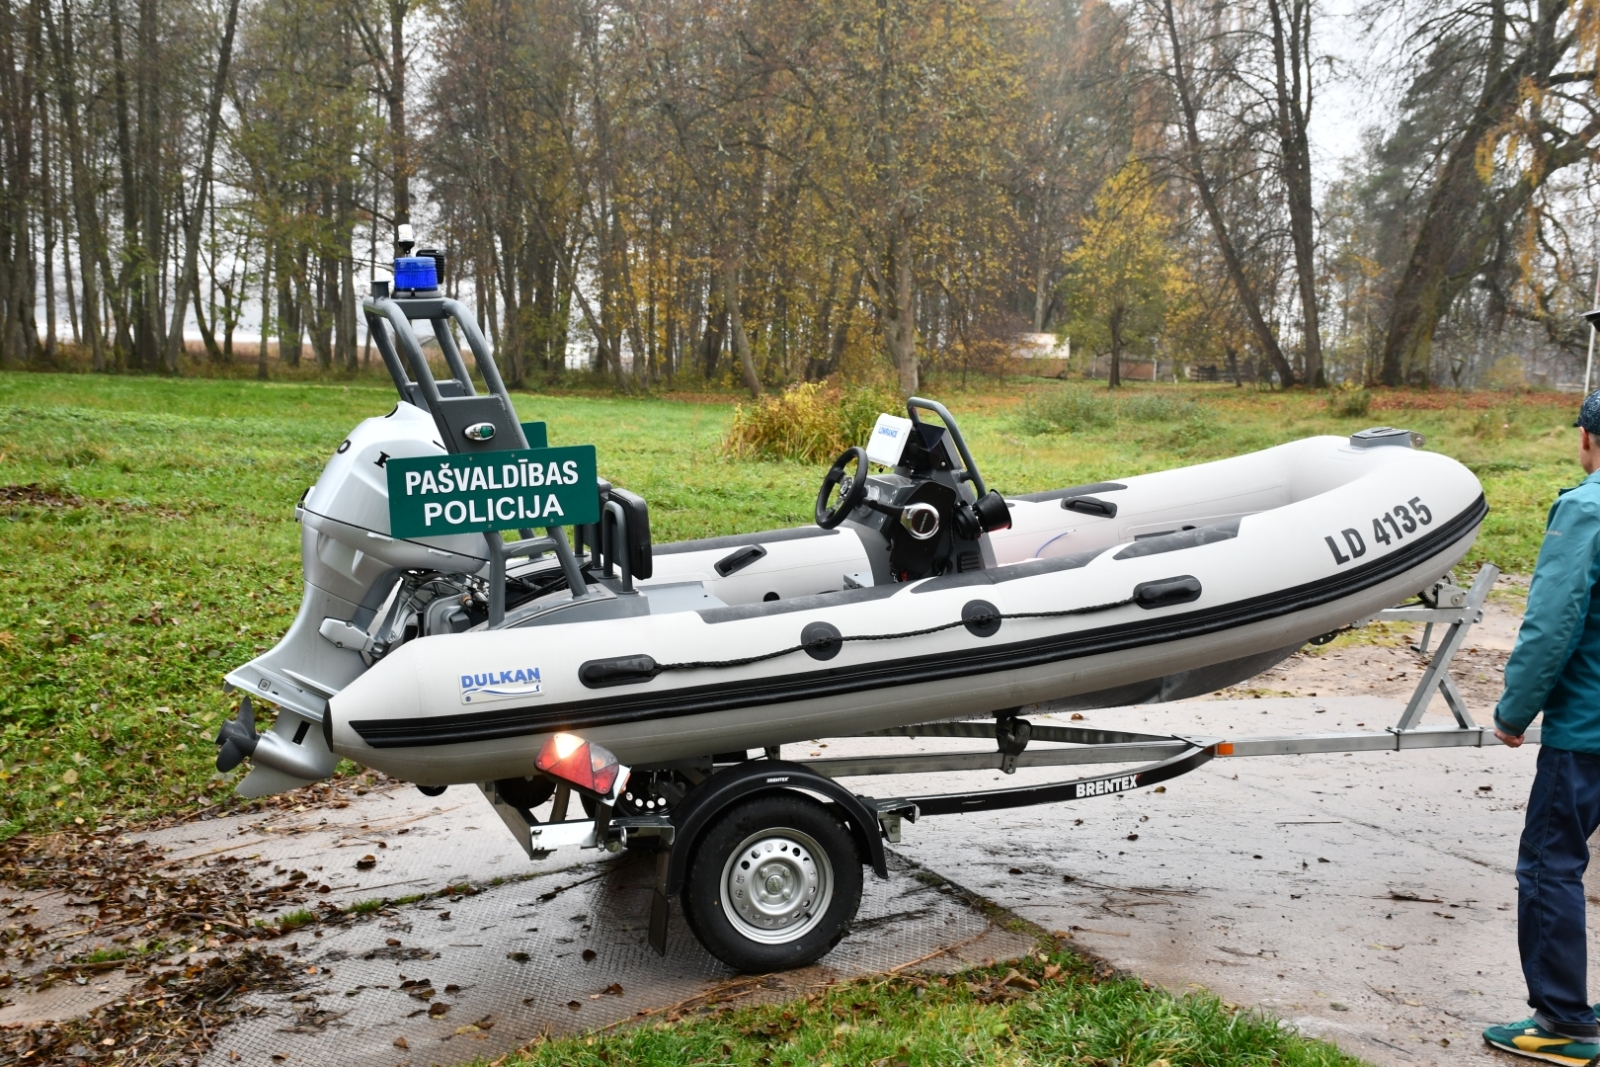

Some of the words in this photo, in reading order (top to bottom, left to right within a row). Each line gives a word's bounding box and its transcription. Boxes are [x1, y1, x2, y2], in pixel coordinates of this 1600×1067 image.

[878, 427, 899, 438] LOWRANCE
[405, 459, 579, 496] PAŠVALDĪBAS
[424, 494, 564, 526] POLICIJA
[1324, 535, 1366, 565] LD
[1372, 496, 1432, 546] 4135
[461, 668, 540, 688] DULKAN
[1076, 774, 1139, 798] BRENTEX
